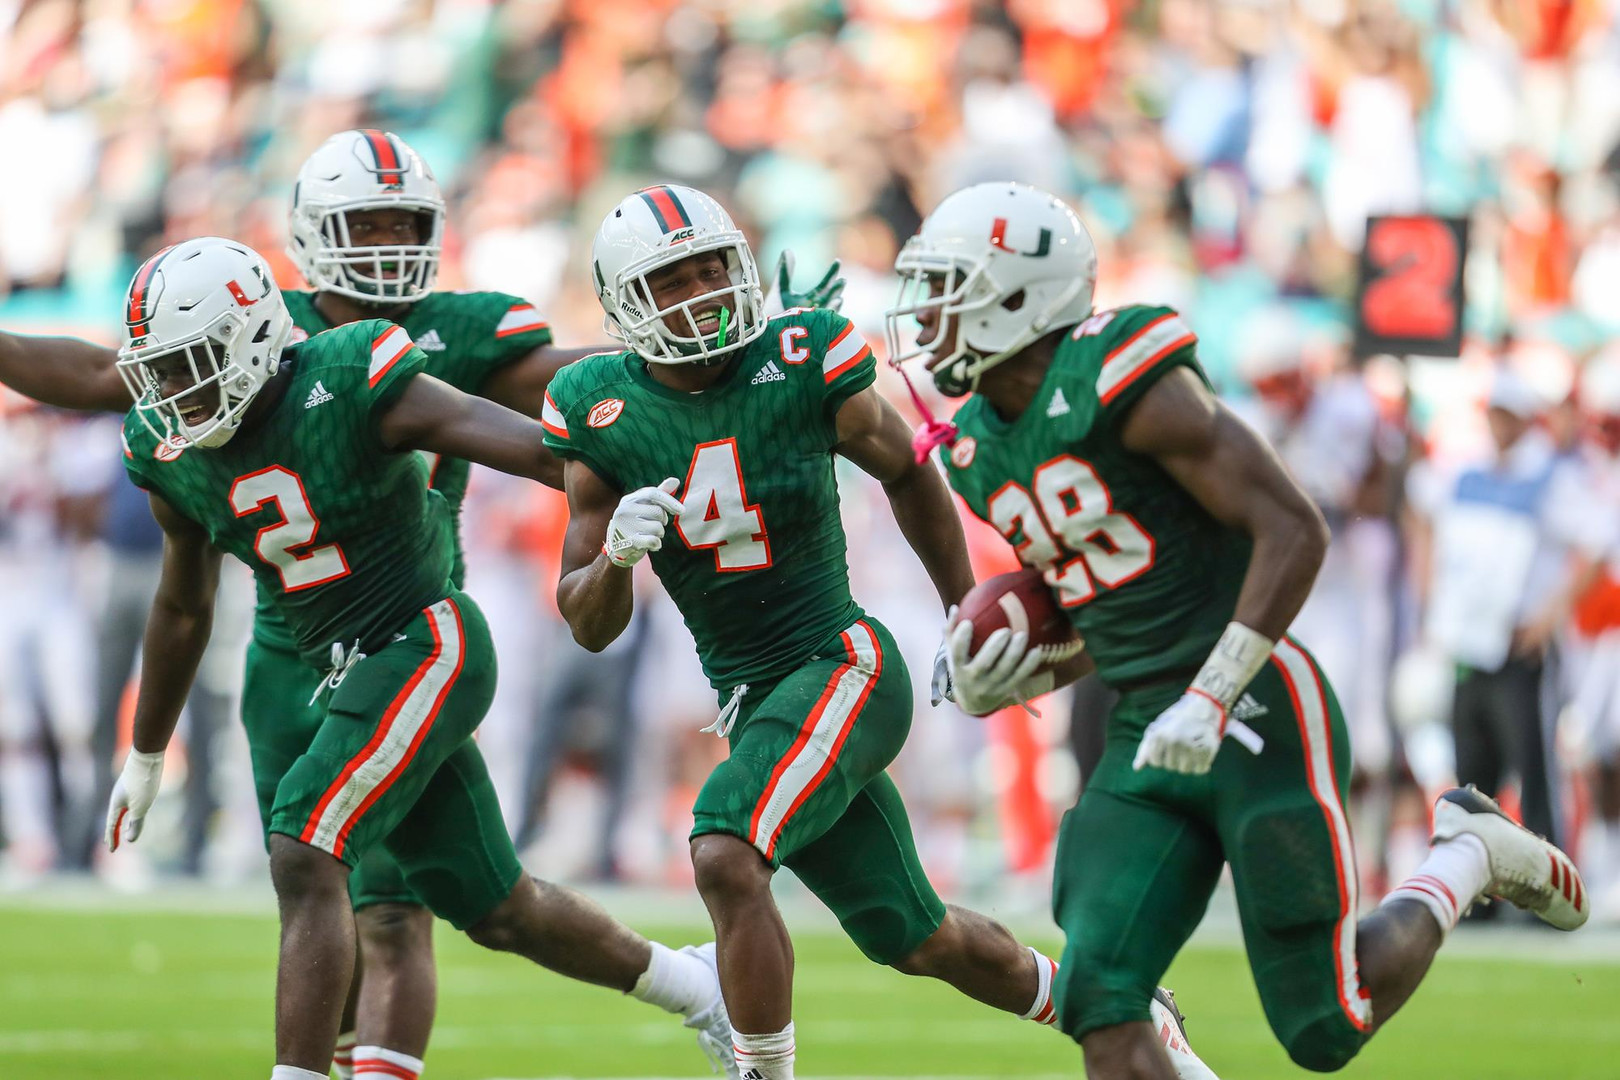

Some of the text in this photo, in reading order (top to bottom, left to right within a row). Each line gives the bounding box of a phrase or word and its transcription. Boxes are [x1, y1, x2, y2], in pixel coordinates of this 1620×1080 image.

[670, 228, 695, 243] ACC
[1361, 214, 1458, 340] 2
[621, 301, 645, 320] Ridde
[779, 325, 811, 365] C
[751, 371, 786, 385] adidas
[304, 391, 335, 410] adidas
[593, 401, 618, 423] ACC
[673, 436, 773, 573] 4
[228, 464, 352, 593] 2
[987, 453, 1157, 608] 28
